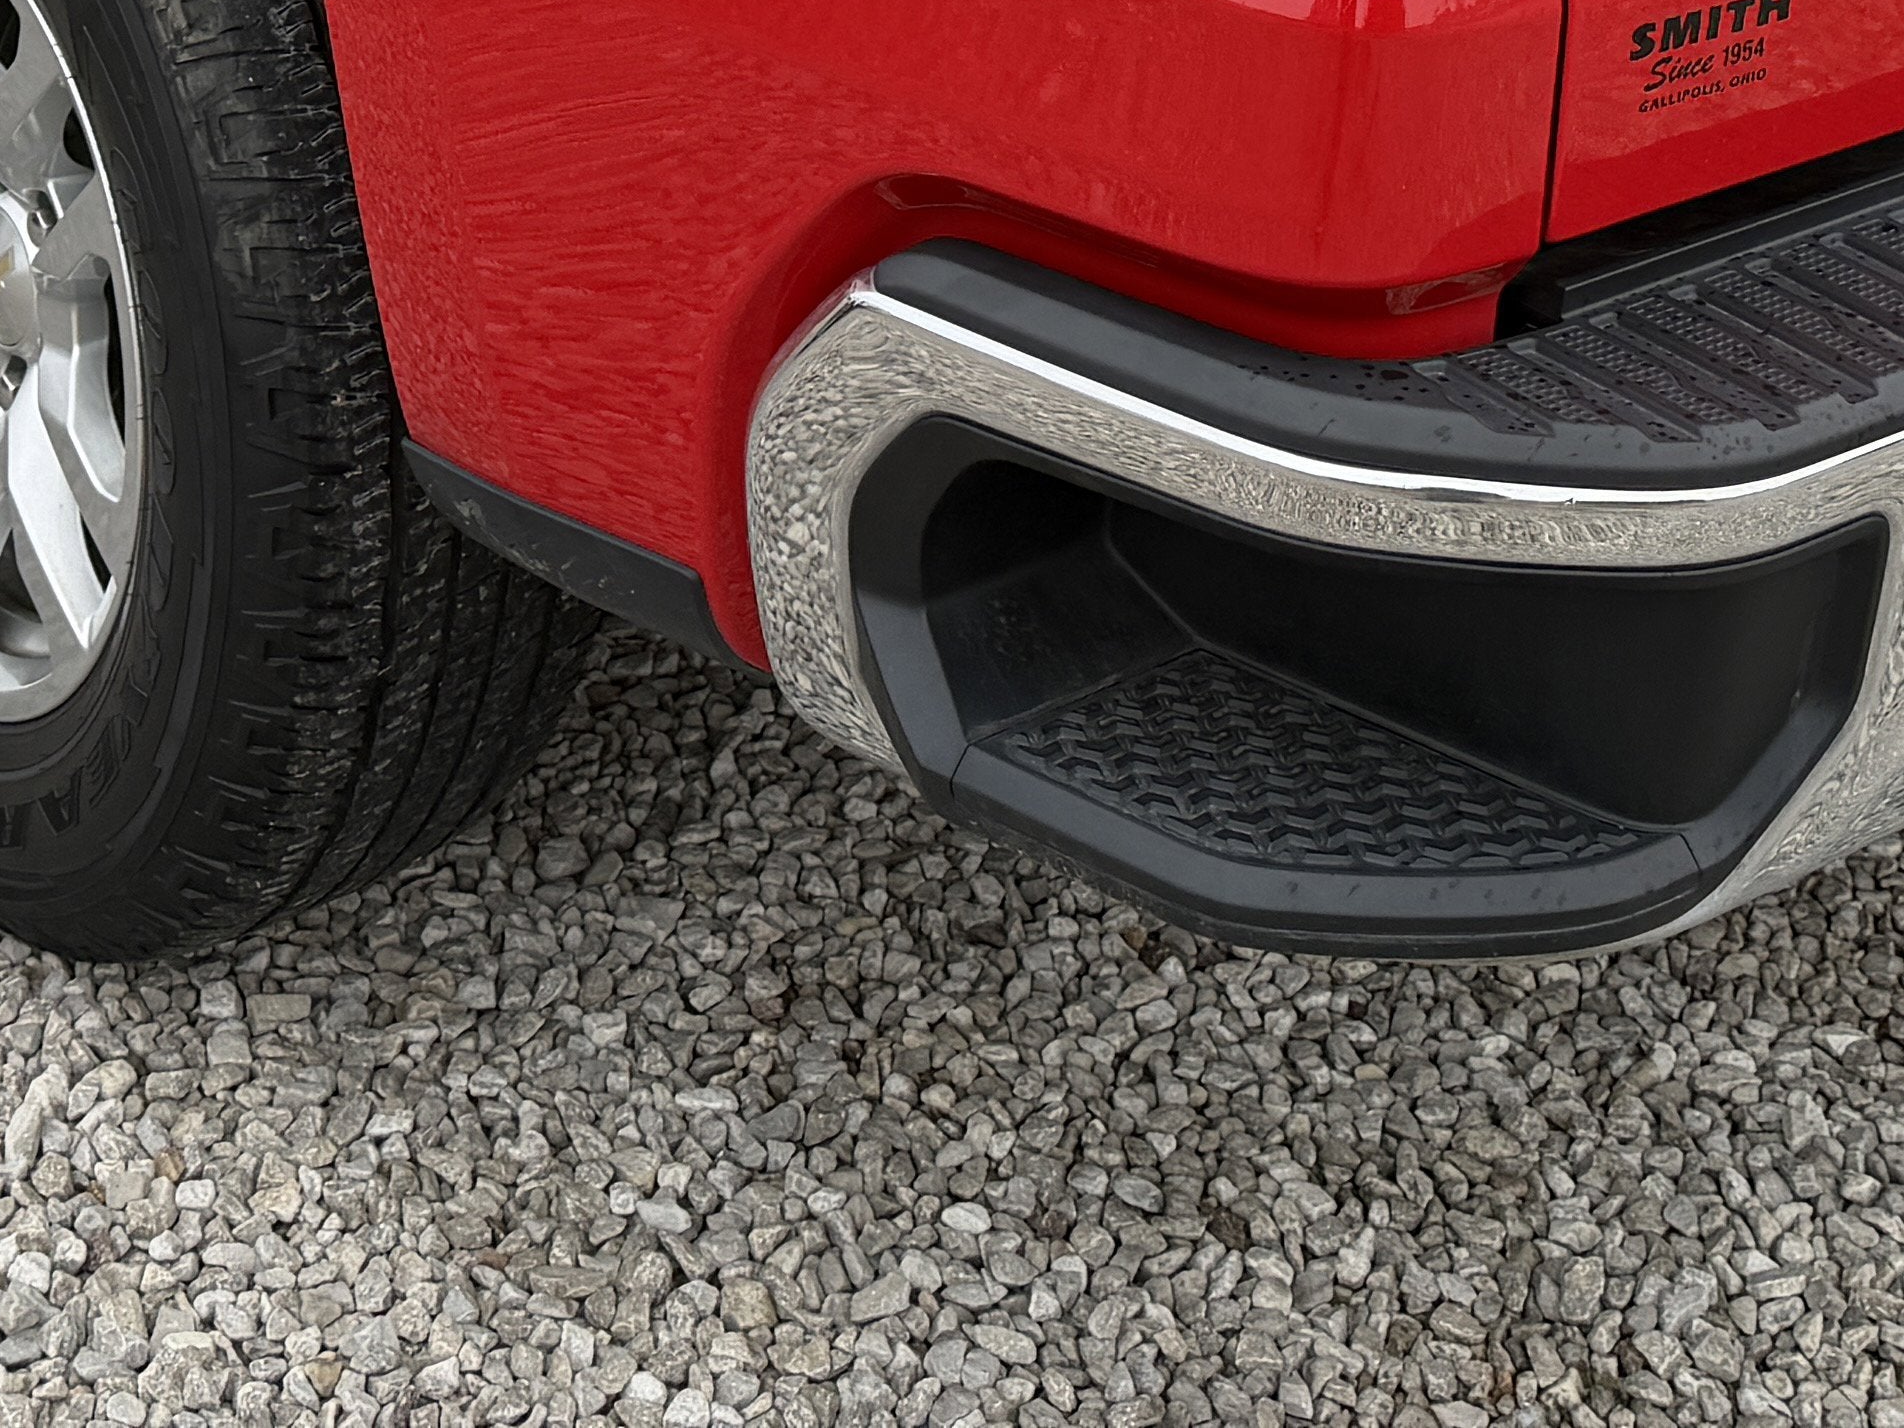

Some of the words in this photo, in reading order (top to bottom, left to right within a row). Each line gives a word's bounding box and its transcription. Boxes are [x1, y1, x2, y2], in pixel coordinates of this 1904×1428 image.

[1643, 55, 1716, 92] Since
[1722, 37, 1766, 68] 1954
[1729, 67, 1767, 88] OHIO
